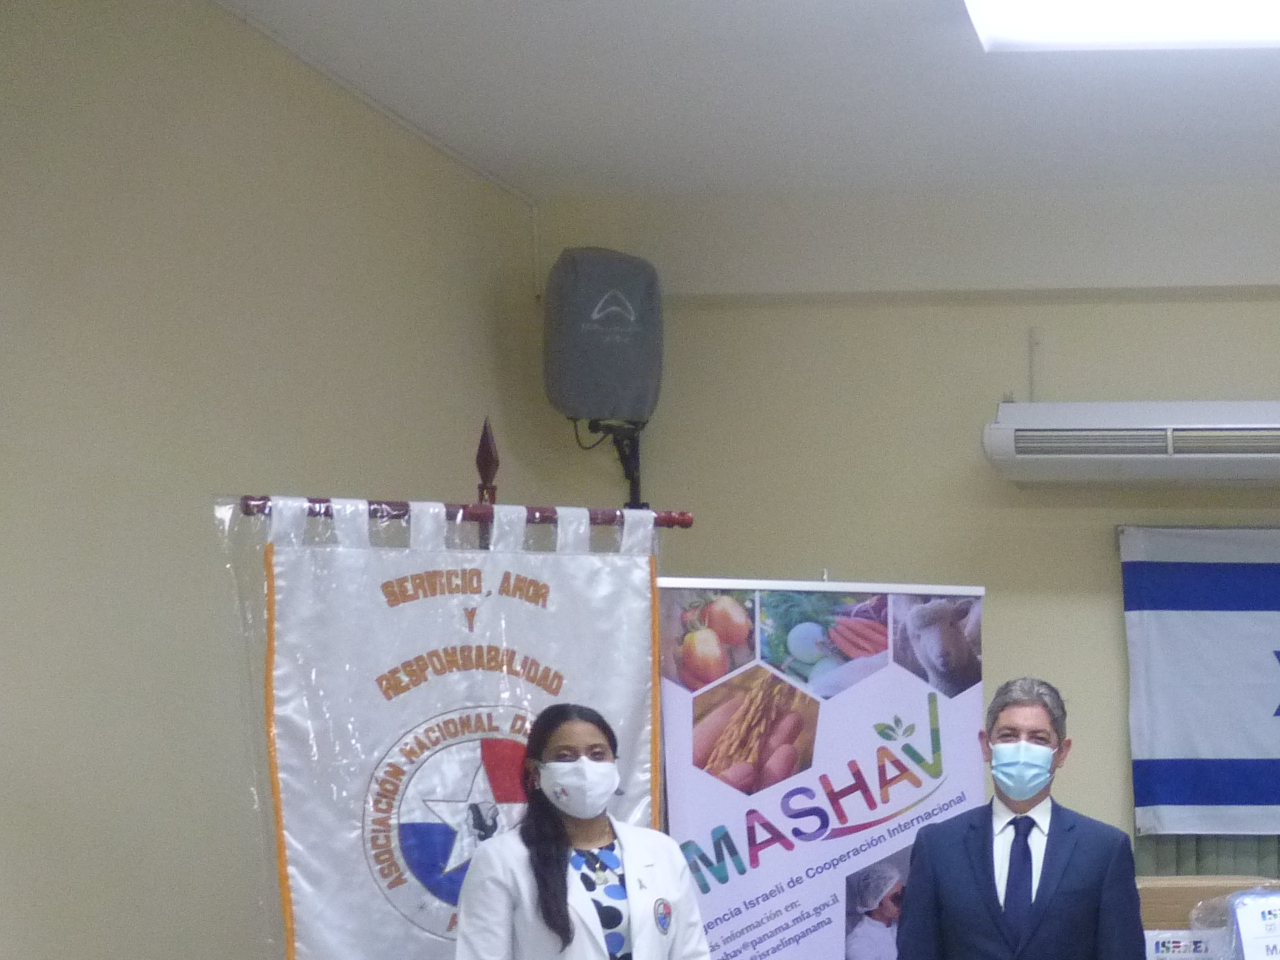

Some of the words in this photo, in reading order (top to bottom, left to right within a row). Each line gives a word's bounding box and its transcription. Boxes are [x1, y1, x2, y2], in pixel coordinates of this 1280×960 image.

[499, 571, 550, 609] AMOR
[463, 607, 477, 632] Y
[375, 645, 564, 701] RESPONSABILIDAD
[399, 713, 499, 764] NACIONAL
[679, 691, 943, 895] MASHAV
[787, 875, 804, 890] de
[805, 831, 886, 878] Cooperación
[887, 791, 967, 840] Internacional
[709, 941, 721, 953] ás
[721, 909, 783, 946] información
[784, 899, 802, 913] en:
